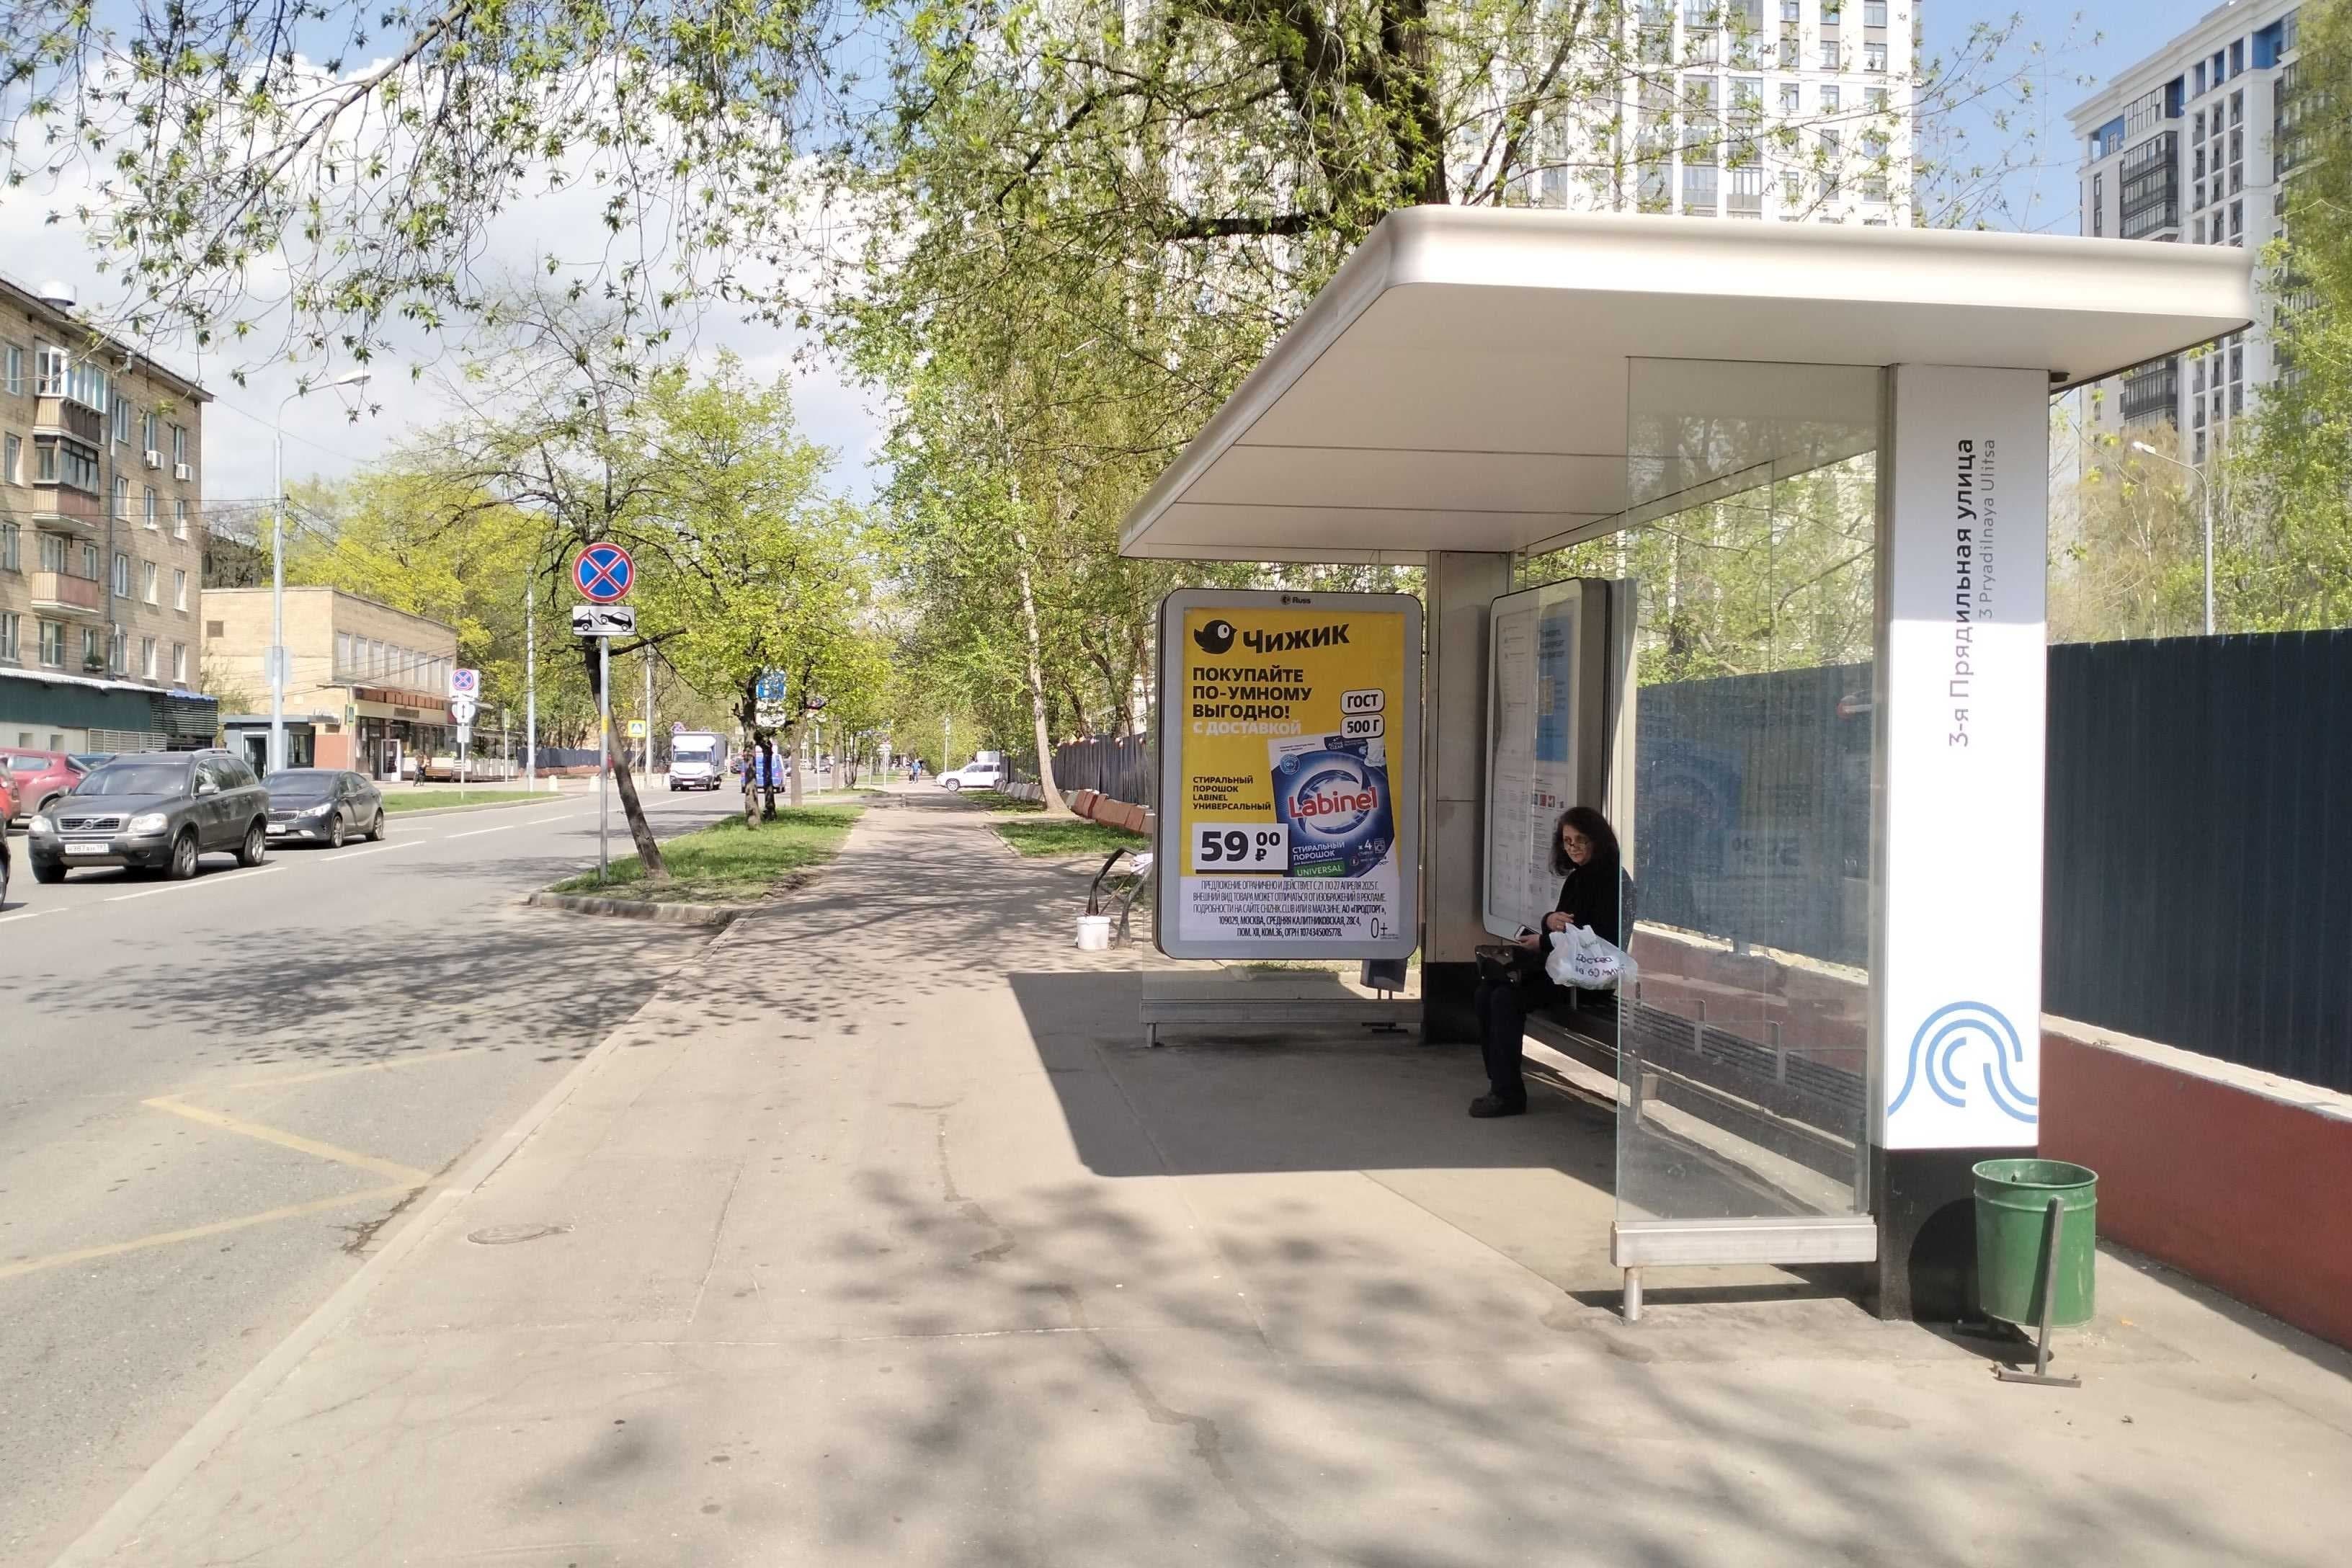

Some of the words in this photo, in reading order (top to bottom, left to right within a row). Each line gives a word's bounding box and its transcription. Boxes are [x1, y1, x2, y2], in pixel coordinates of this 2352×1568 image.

[1980, 439, 1995, 491] Ulitsa
[1958, 438, 1977, 520] улица
[1979, 497, 1997, 602] Pryadilnaya
[1949, 527, 1974, 698] Прядильная
[1979, 608, 1992, 619] 3
[1193, 665, 1304, 682] ПОКУПАЙТЕ
[1193, 685, 1312, 701] ПО-УМНОМУ
[1347, 695, 1379, 708] ГОСТ
[1193, 703, 1290, 721] ВЫГОДНО!
[1193, 721, 1203, 734] С
[1206, 720, 1301, 736] ДОСТАВКОЙ
[1347, 719, 1370, 734] 500
[1372, 719, 1380, 732] Г
[1949, 708, 1969, 747] 3-я
[1193, 775, 1254, 784] СТИРАЛЬНЫЙ
[1193, 801, 1271, 811] УНИВЕРСАЛЬНЫЙ
[1288, 787, 1378, 819] Labinel
[1200, 830, 1249, 862] 59
[1256, 832, 1280, 847] 00
[1292, 842, 1345, 854] СТИРАЛЬНЫЙ
[1293, 850, 1335, 861] ПОРОШОК
[1297, 866, 1342, 877] UNIVERSAL
[1201, 881, 1242, 891] ПРЕДЛОЖЕНИЕ
[1283, 879, 1311, 891] ДЕЙСТВУЕТ
[1325, 881, 1333, 890] ПО
[1340, 881, 1360, 890] АПРЕЛЯ
[1193, 891, 1220, 901] ВНЕШНИЙ
[1221, 893, 1233, 902] ВИД
[1234, 893, 1254, 901] ТОВАРА
[1254, 893, 1274, 901] МОЖЕТ
[1234, 904, 1242, 913] НА
[1243, 902, 1260, 913] САЙТЕ
[1240, 917, 1265, 926] МОСКВА,
[1266, 917, 1292, 926] СРЕДНЯЯ
[1371, 917, 1388, 938] 0+
